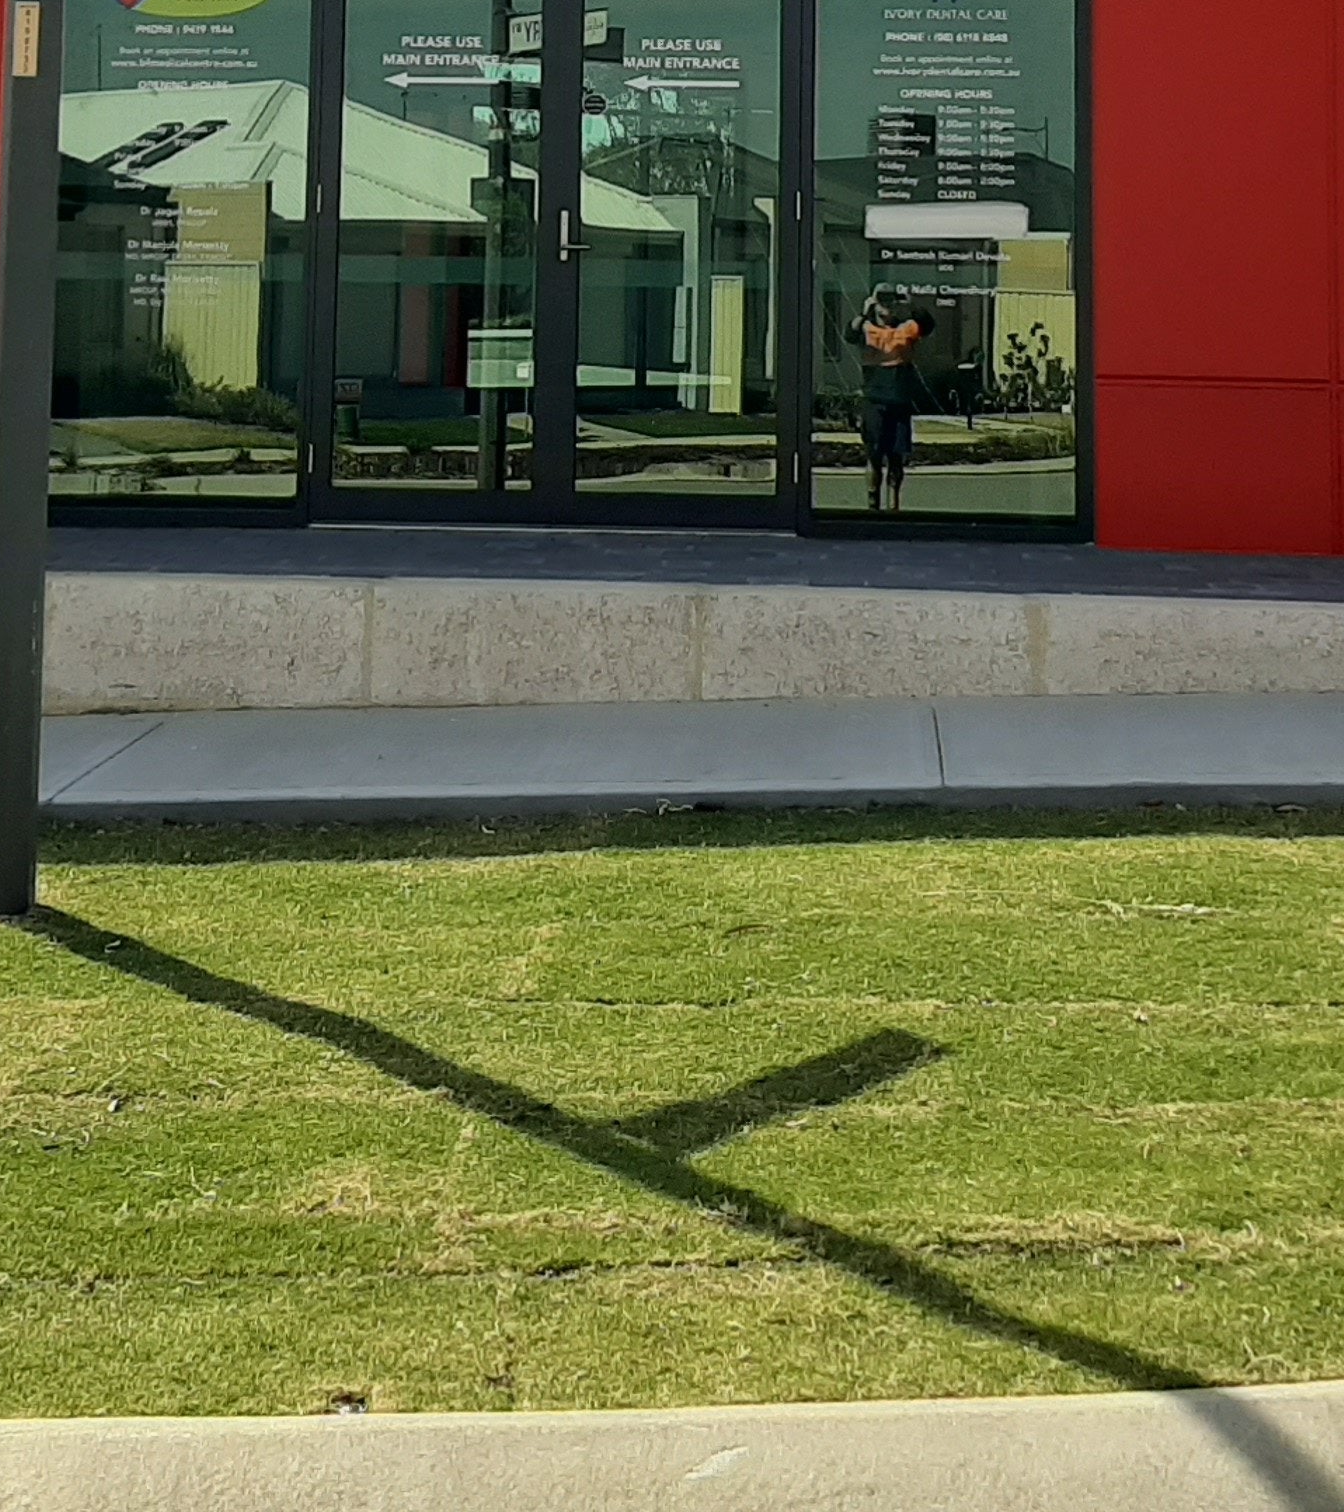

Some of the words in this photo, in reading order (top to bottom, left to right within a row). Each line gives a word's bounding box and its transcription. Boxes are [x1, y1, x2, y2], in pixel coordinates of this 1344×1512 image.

[883, 9, 922, 20] IVORY
[926, 9, 973, 20] DENTAL
[976, 9, 1008, 20] CARE
[400, 35, 452, 48] PLEASE
[456, 35, 483, 48] USE
[885, 32, 924, 42] PHONE
[640, 38, 692, 51] PLEASE
[695, 38, 723, 51] USE
[382, 53, 421, 66] MAIN
[424, 53, 501, 66] ENTRANCE
[623, 56, 662, 70] MAIN
[664, 56, 741, 69] ENTRANCE
[918, 55, 973, 65] appointment
[899, 89, 952, 100] OPENING
[954, 89, 993, 99] HOURS
[877, 189, 911, 199] Sunday
[937, 190, 977, 200] CLOSED
[881, 249, 894, 259] Dr
[896, 283, 908, 294] Dr
